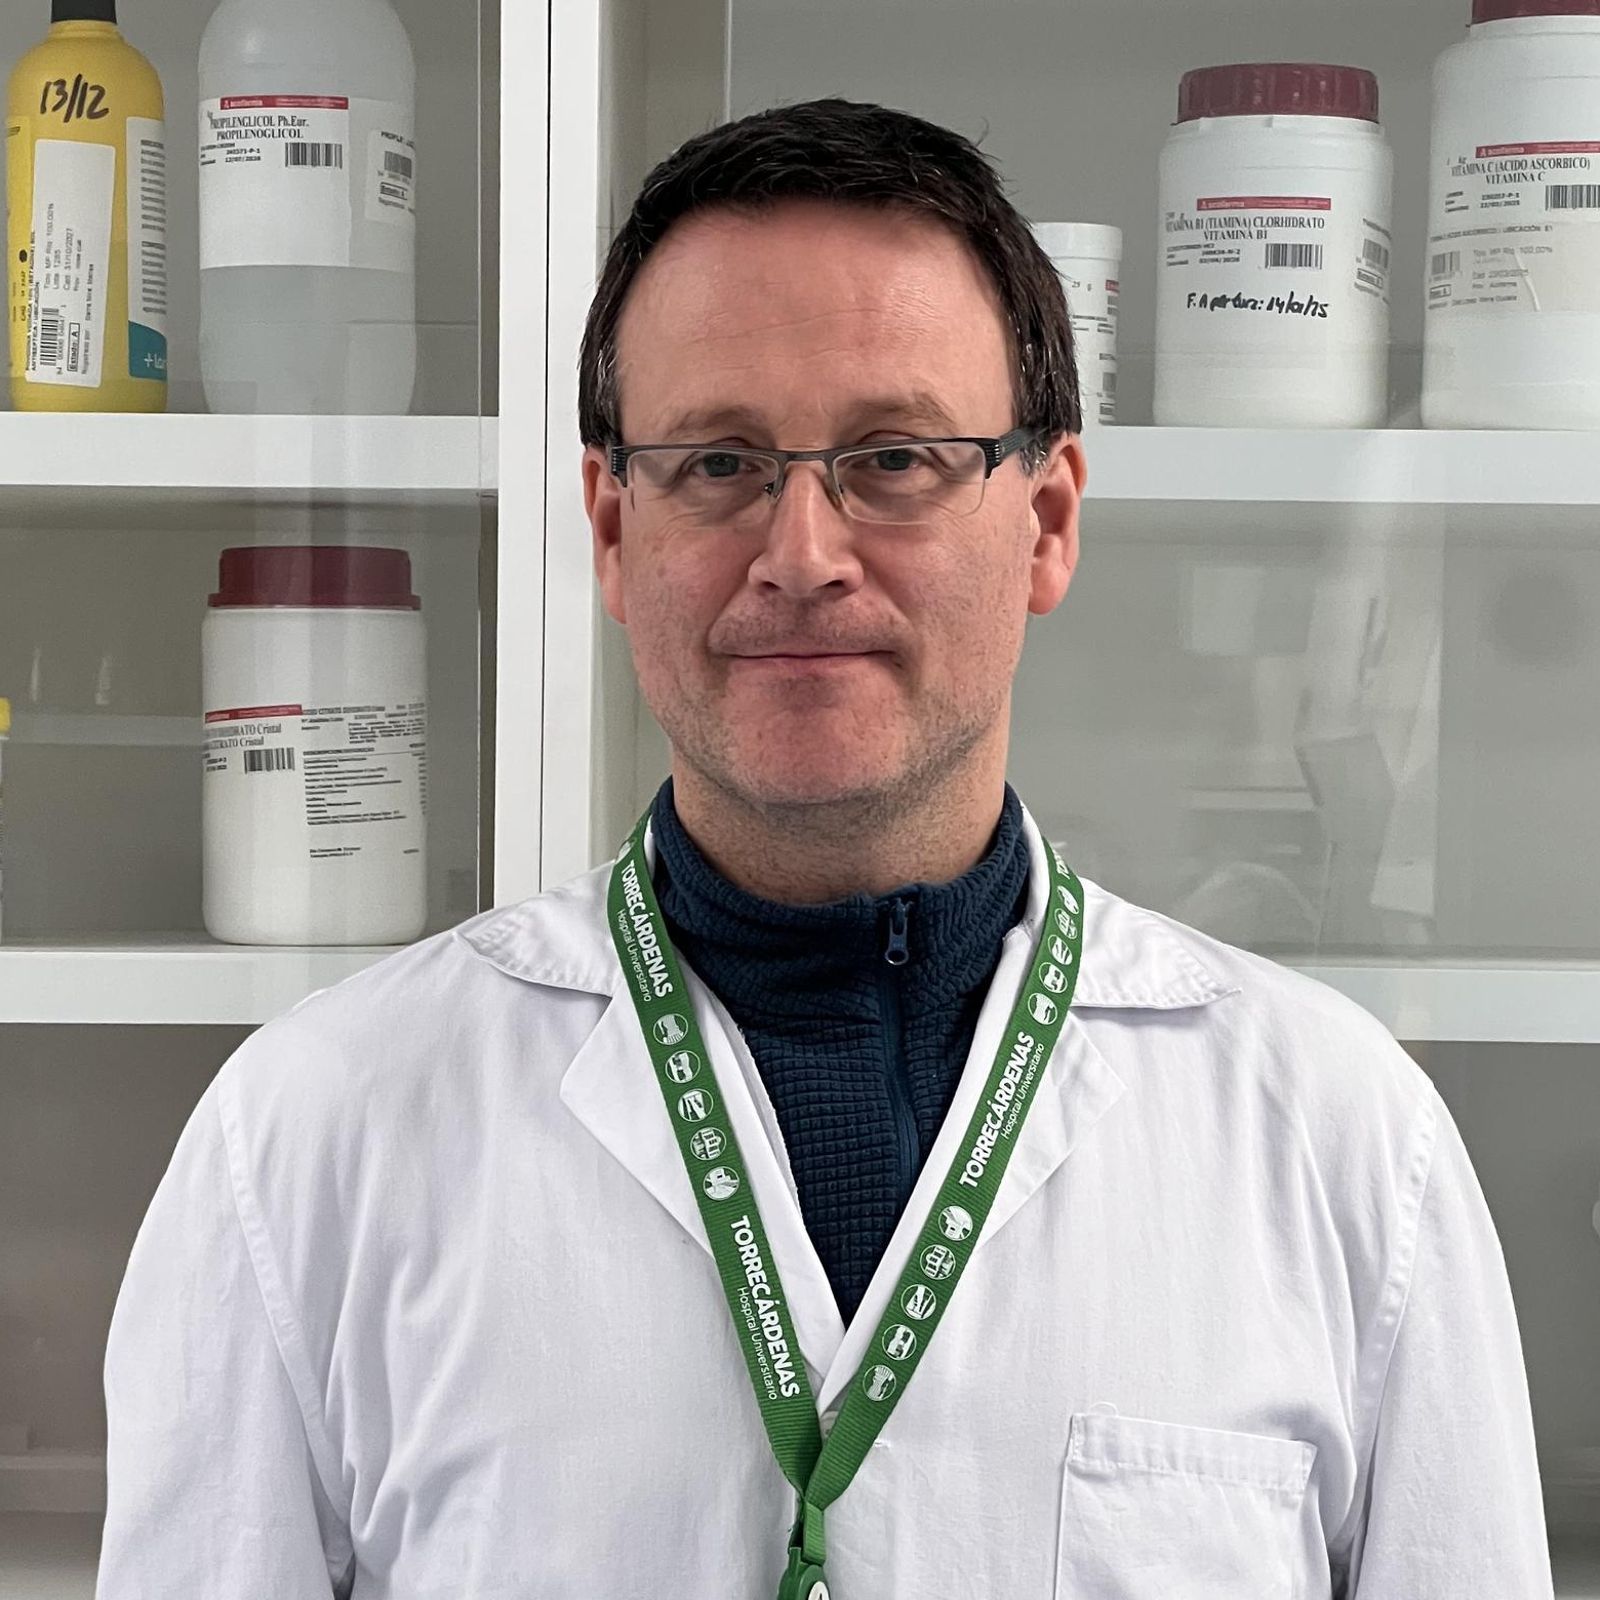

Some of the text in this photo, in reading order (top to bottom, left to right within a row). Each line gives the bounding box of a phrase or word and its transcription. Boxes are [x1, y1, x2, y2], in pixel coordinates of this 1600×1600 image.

[40, 73, 110, 123] 13/12
[216, 128, 304, 141] PROPILENOGLICOL
[1530, 157, 1591, 171] ASCORBICO)
[1485, 172, 1546, 185] VITAMINA C
[1203, 229, 1268, 241] VITAMINA B1
[1205, 216, 1251, 231] (TIAMINA)
[1253, 217, 1325, 230] CLORHIDRATO
[616, 909, 652, 1003] Hospital Universitario
[621, 859, 674, 998] TORRECÁRDENAS
[959, 1031, 1035, 1188] TORRECÁRDENAS
[1000, 1043, 1045, 1140] Hospital Universitario
[730, 1214, 800, 1398] TORRECÁRDENAS
[737, 1286, 778, 1400] Hospital Universitario
